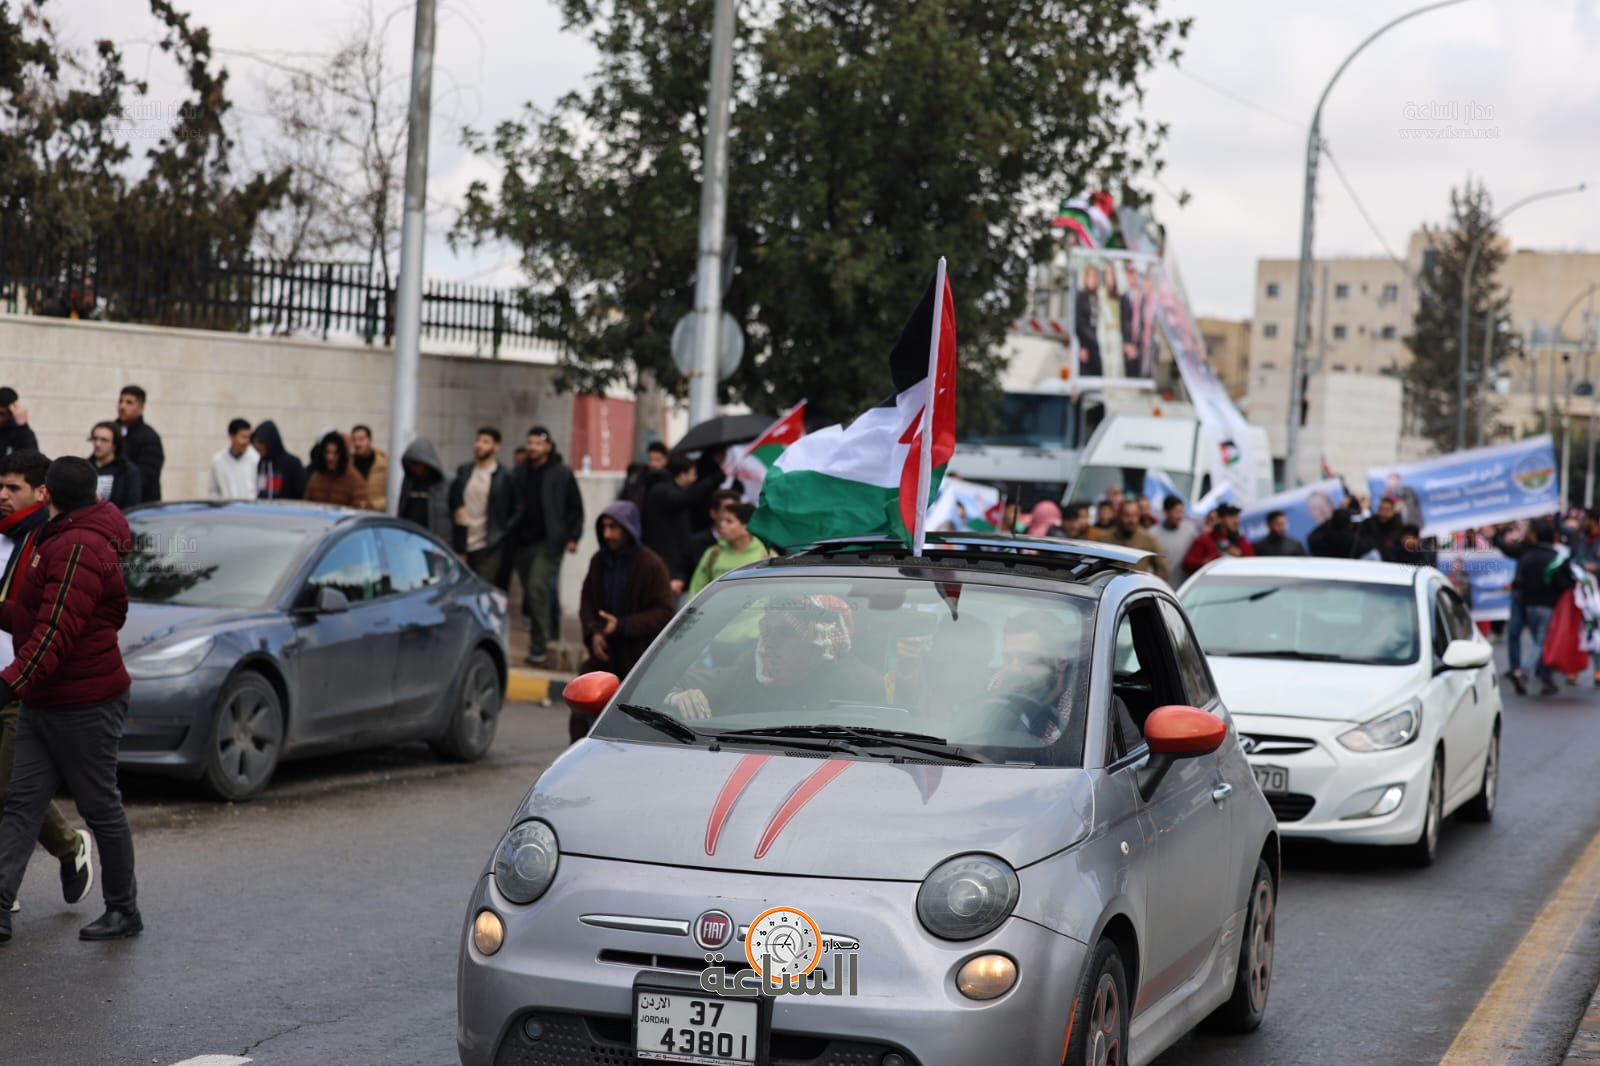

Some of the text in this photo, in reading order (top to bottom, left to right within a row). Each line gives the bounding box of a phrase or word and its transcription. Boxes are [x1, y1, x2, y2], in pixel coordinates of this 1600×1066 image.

[703, 921, 726, 939] FIAT
[640, 1015, 670, 1025] JORDAN
[689, 1001, 724, 1027] 37
[660, 1028, 747, 1060] 43801
